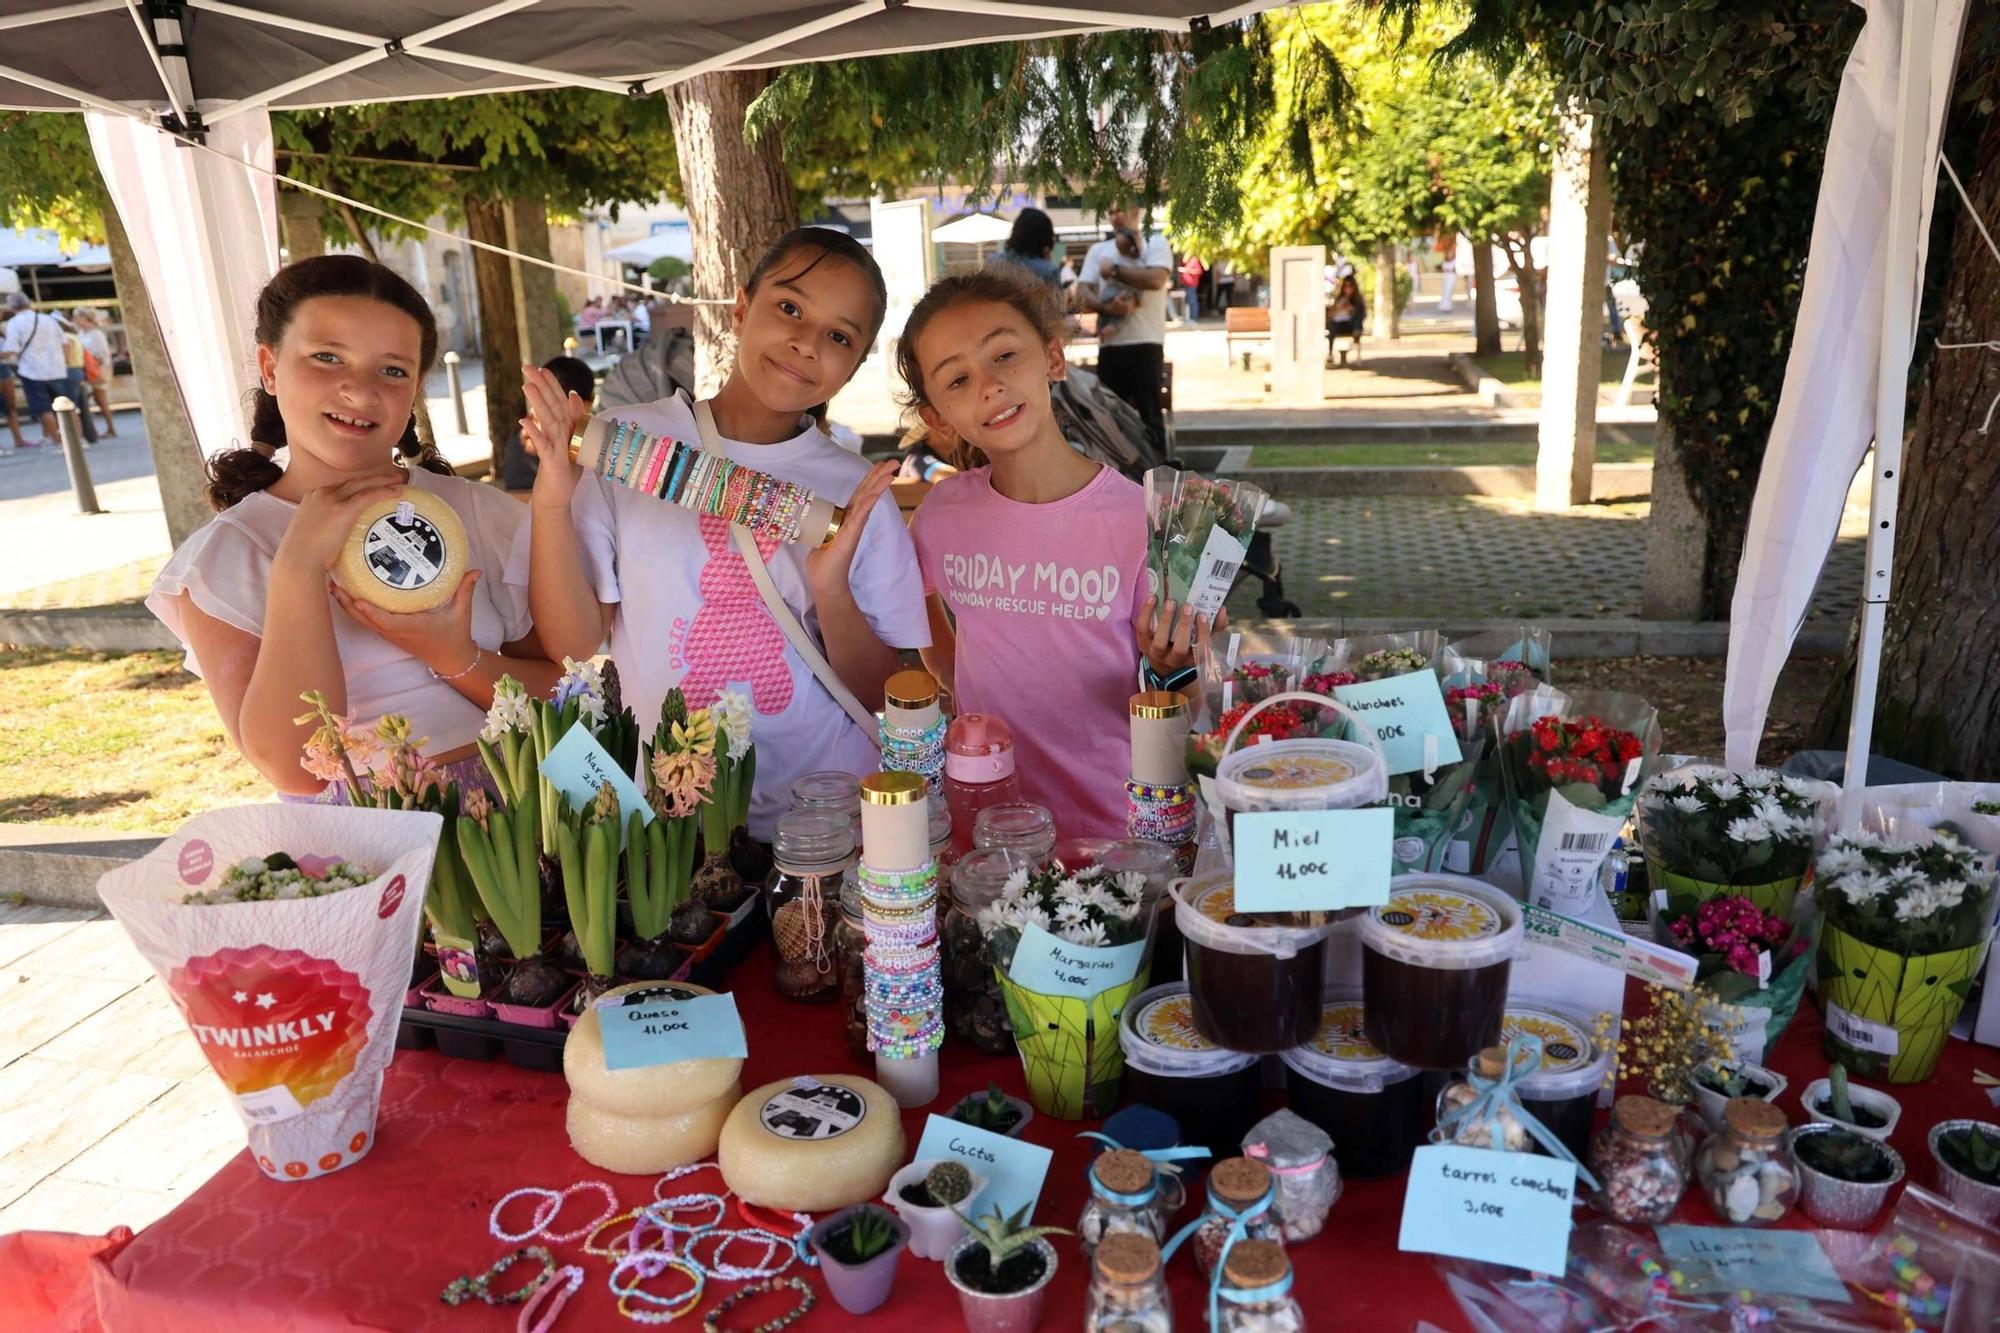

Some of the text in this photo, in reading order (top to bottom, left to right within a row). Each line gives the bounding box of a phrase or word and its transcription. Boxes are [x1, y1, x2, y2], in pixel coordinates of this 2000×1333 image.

[943, 553, 1120, 603] FRIDAY MOOD
[950, 590, 1095, 620] MONDAY RESCUE HELP
[1377, 725, 1405, 740] 00€
[584, 751, 608, 781] Narc
[1273, 829, 1319, 849] Miel
[1054, 969, 1089, 986] 4,00€
[628, 1009, 679, 1021] Queso
[192, 1010, 336, 1048] TWINKLY
[642, 1022, 690, 1034] 11,00€
[948, 1137, 995, 1162] Cactus
[1441, 1163, 1496, 1184] tarros
[1463, 1199, 1504, 1218] 3,00€
